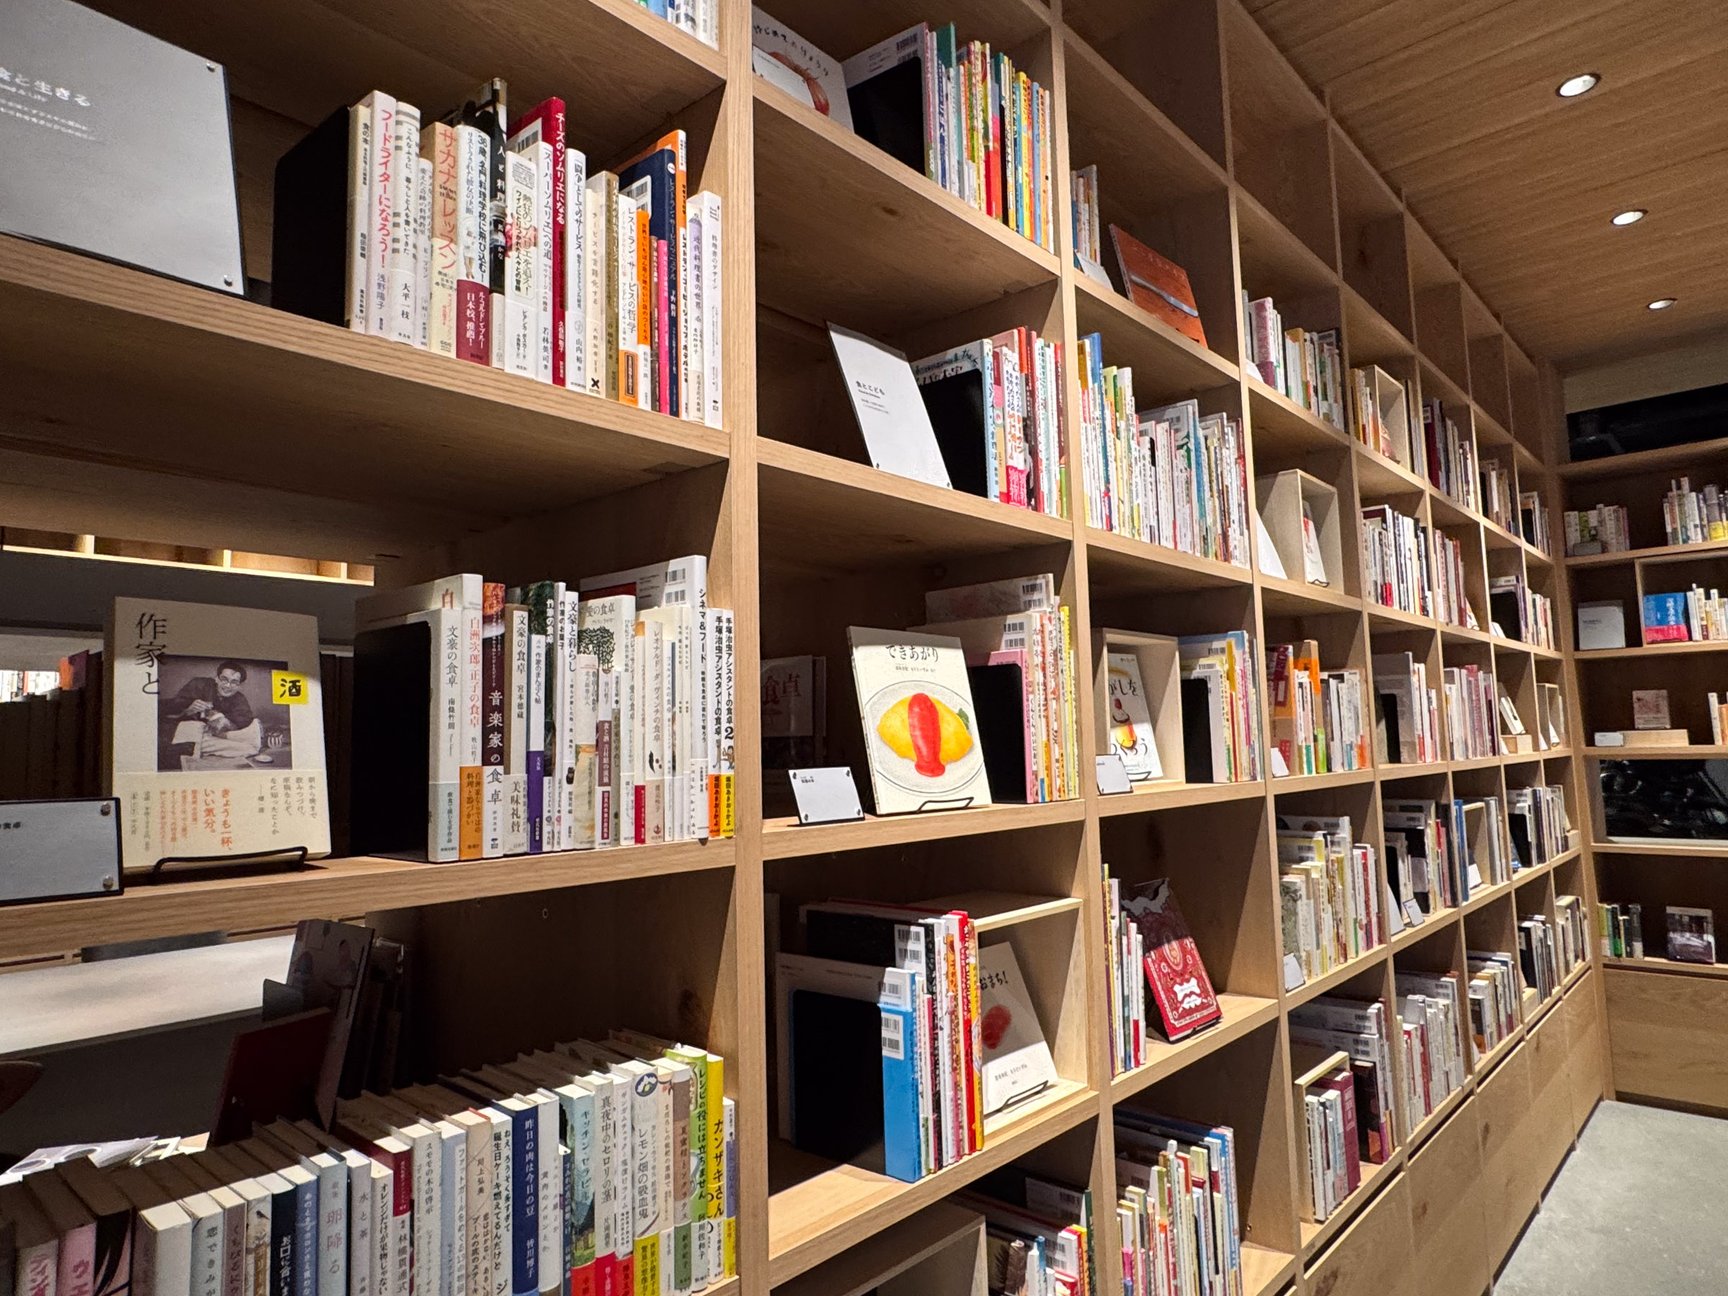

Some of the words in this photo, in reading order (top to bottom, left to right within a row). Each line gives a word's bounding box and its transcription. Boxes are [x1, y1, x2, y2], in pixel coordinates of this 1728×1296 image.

[555, 115, 568, 226] チーズのソムリエになる
[401, 282, 412, 321] 大平一枝
[134, 611, 168, 696] 作家と
[280, 674, 303, 704] 酒
[714, 615, 724, 737] 手塚治虫アシスタントの食卓
[725, 617, 734, 727] 手塚治虫アシスタントの食卓
[885, 643, 939, 663] できあがり
[487, 688, 504, 806] 音楽家の食卓
[724, 725, 734, 741] 2
[203, 788, 217, 833] いい気分。
[221, 788, 234, 851] きょうも一杯、
[477, 1157, 485, 1195] 川上弘美
[503, 1129, 512, 1233] ねえ、ろうそく多すぎて
[600, 1095, 612, 1205] 真夜中のセロリの茎
[637, 1129, 650, 1221] レモン畑の吸血鬼
[713, 1119, 725, 1219] カンザキさん
[493, 1131, 502, 1271] 誕生日ケーキ燃えてるんだけど
